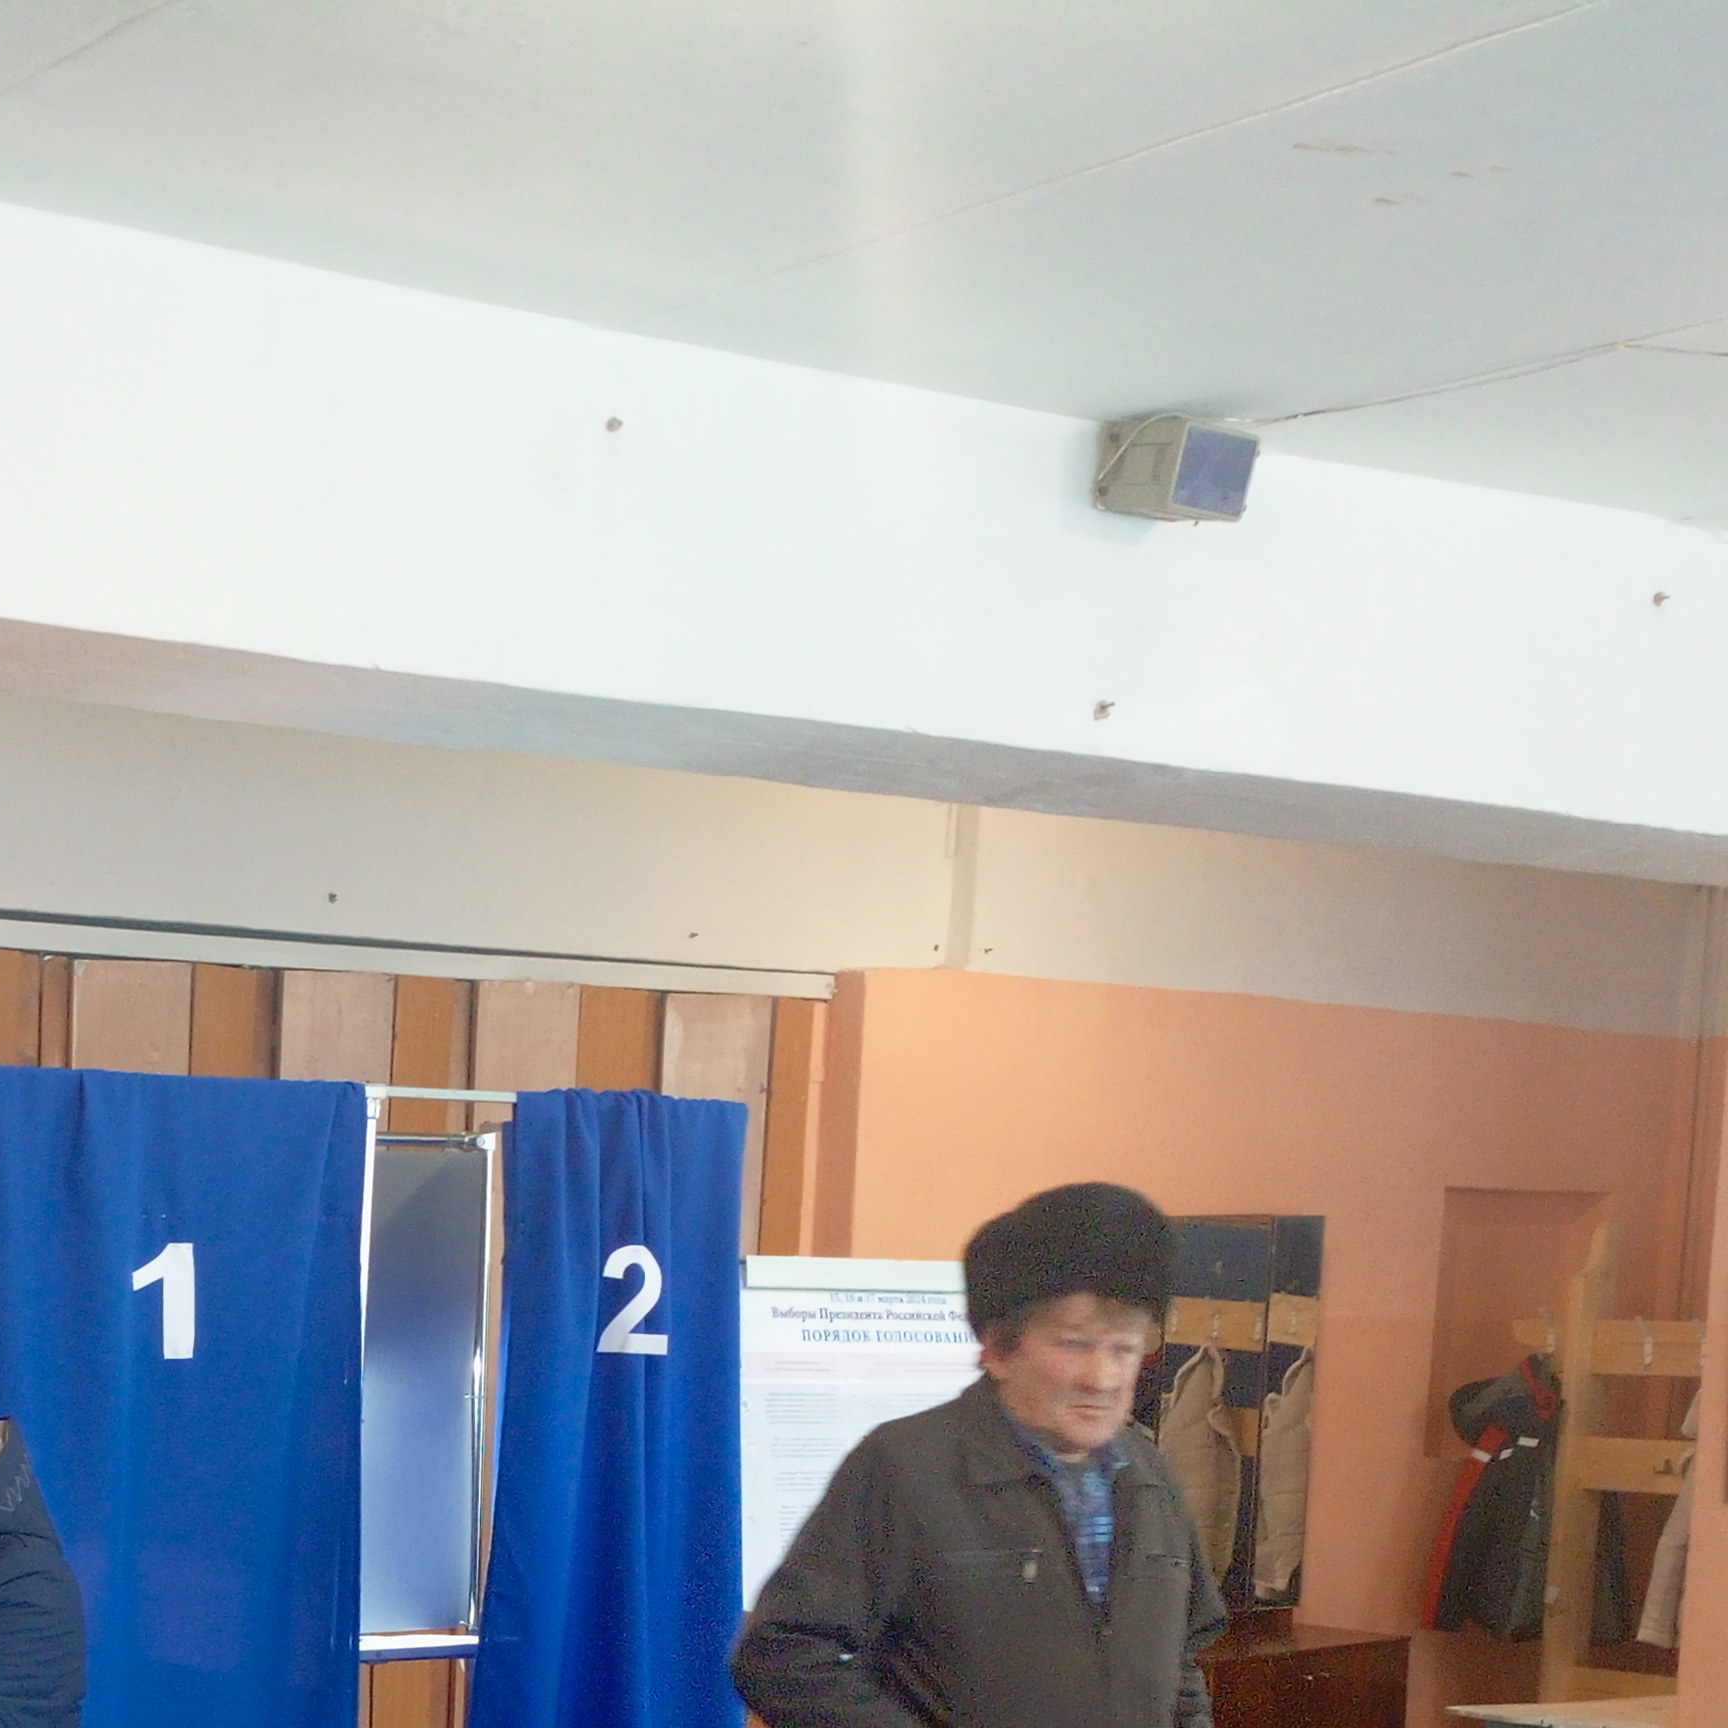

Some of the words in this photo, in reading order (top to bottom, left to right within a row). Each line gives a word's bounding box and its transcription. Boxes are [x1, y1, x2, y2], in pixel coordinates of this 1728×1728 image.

[132, 1242, 195, 1359] 1
[596, 1244, 668, 1355] 2
[771, 1307, 816, 1322] Выборы
[819, 1308, 884, 1323] Президента
[885, 1309, 946, 1322] Российской
[801, 1329, 871, 1343] ПОРЯДОК
